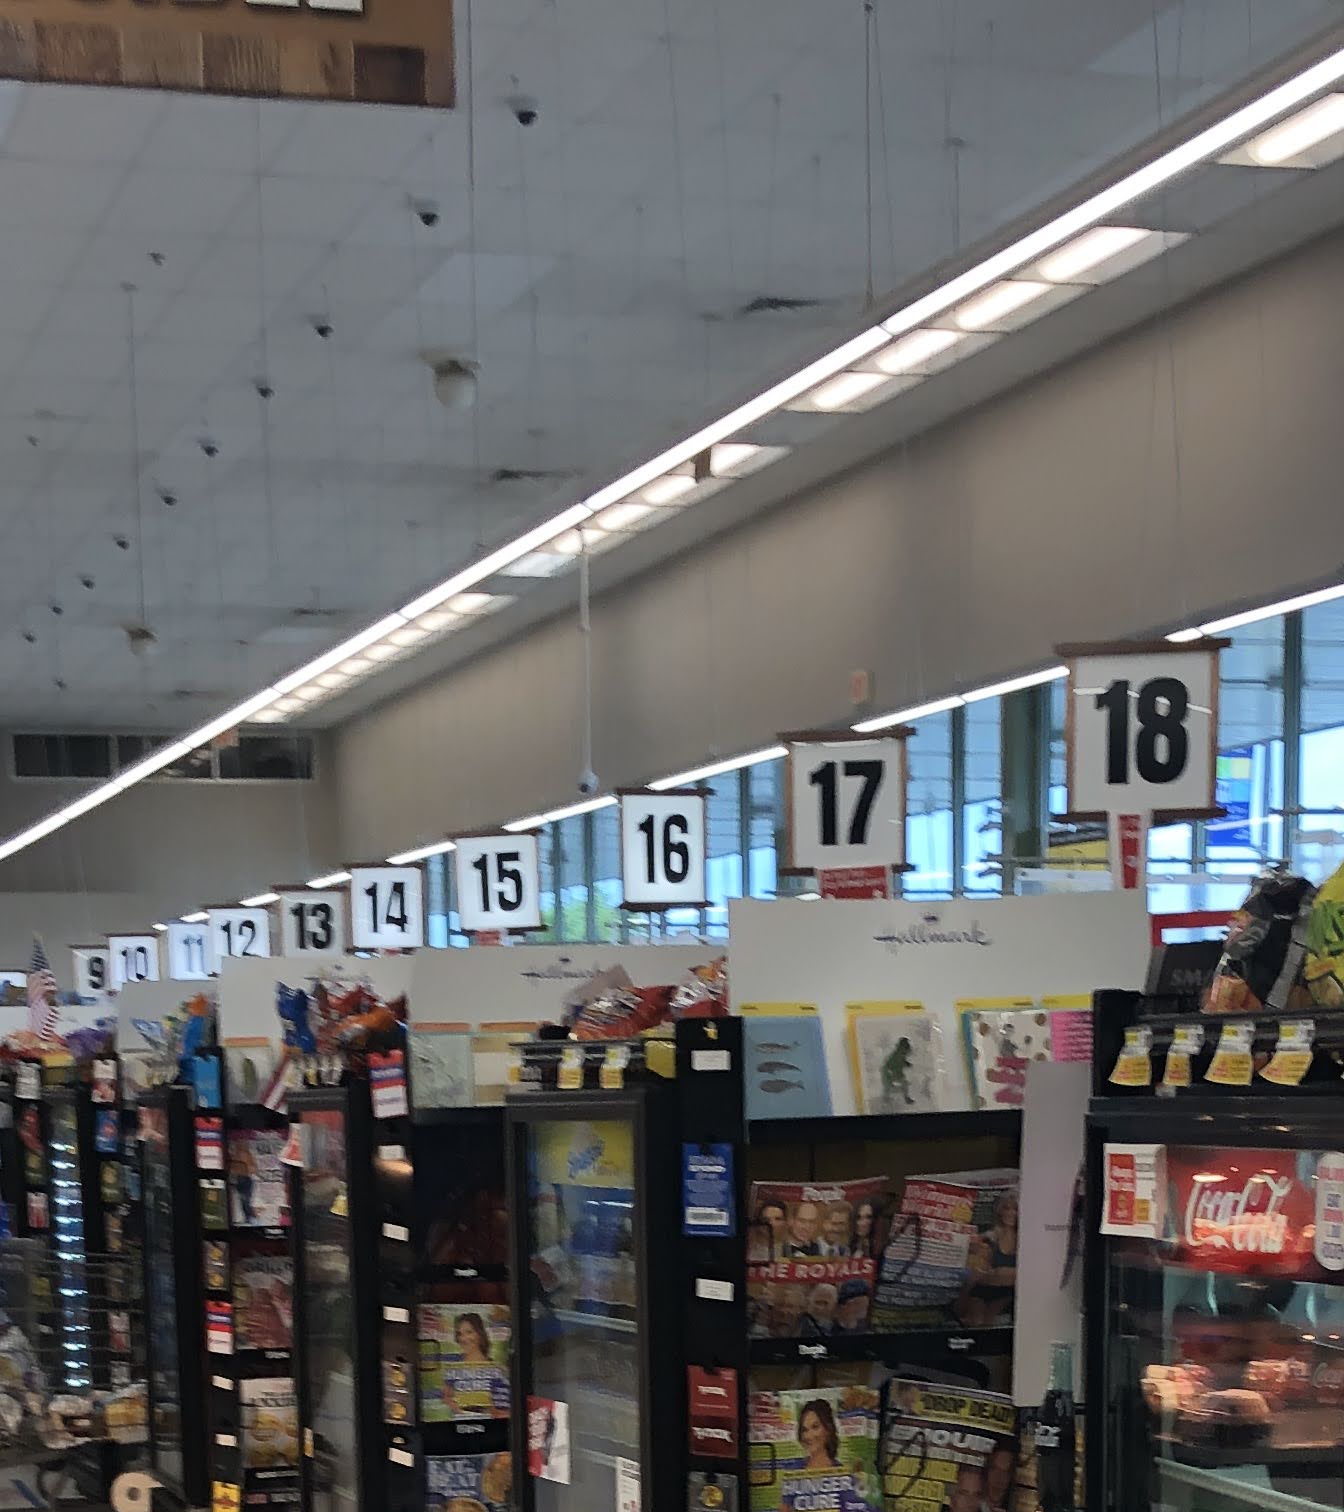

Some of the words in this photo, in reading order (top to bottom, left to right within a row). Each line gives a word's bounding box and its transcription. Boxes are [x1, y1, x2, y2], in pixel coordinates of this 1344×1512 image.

[1096, 677, 1189, 785] 18
[809, 760, 884, 846] 17
[637, 814, 690, 884] 16
[473, 852, 523, 912] 15
[366, 882, 408, 932] 14
[221, 920, 256, 957] 12
[291, 903, 332, 950] 13
[874, 924, 991, 954] Hallmark
[89, 957, 105, 990] 9
[121, 946, 148, 981] 10
[795, 1259, 874, 1279] ROYALS
[782, 1477, 853, 1497] HUNGER
[794, 1494, 841, 1511] CURE
